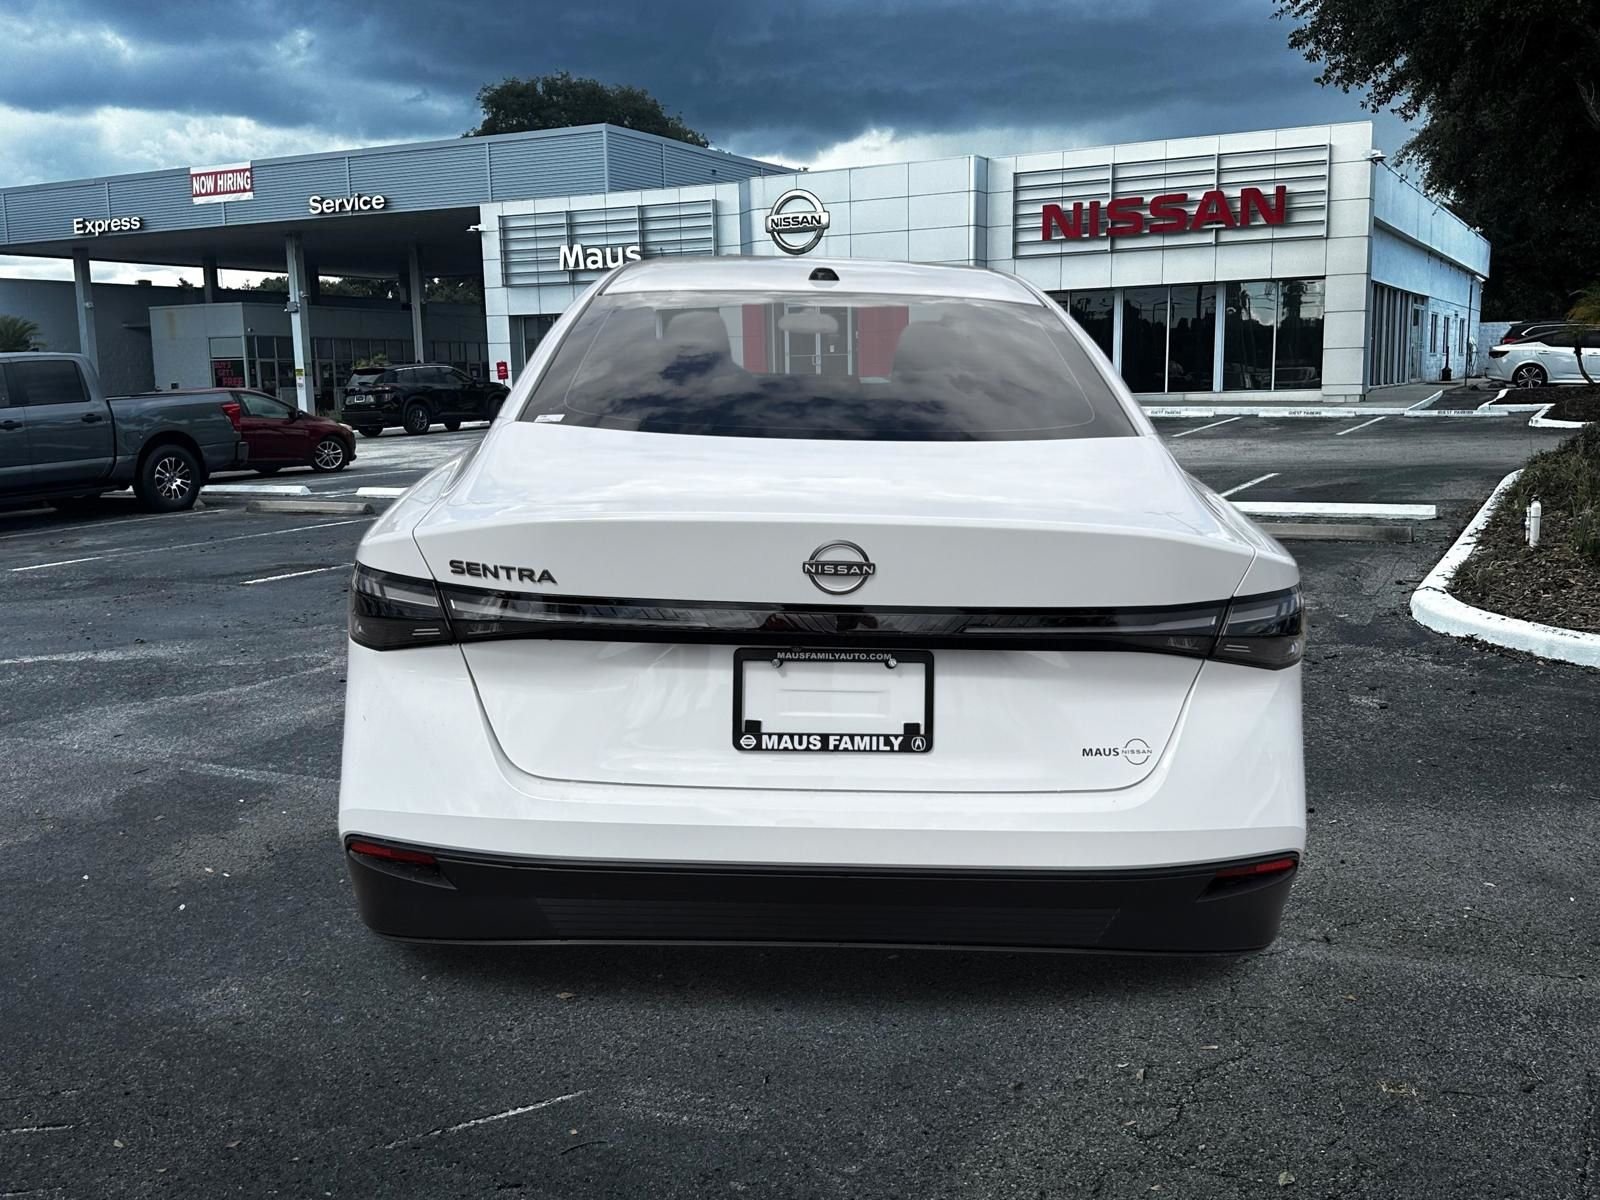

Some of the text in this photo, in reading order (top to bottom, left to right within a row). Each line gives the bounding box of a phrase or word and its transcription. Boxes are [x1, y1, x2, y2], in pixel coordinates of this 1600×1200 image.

[192, 171, 251, 195] NOW HIRING
[308, 193, 385, 214] Service
[1041, 185, 1286, 241] NISSAN
[73, 216, 141, 237] Express
[770, 214, 822, 228] NISSAN
[559, 244, 642, 271] Maus
[448, 559, 557, 585] SENTRA
[804, 563, 875, 575] NISSAN
[777, 651, 893, 661] MAUSFAMILYAUTO.COM
[761, 735, 904, 751] MAUS FAMILY
[1082, 747, 1120, 757] MAUS
